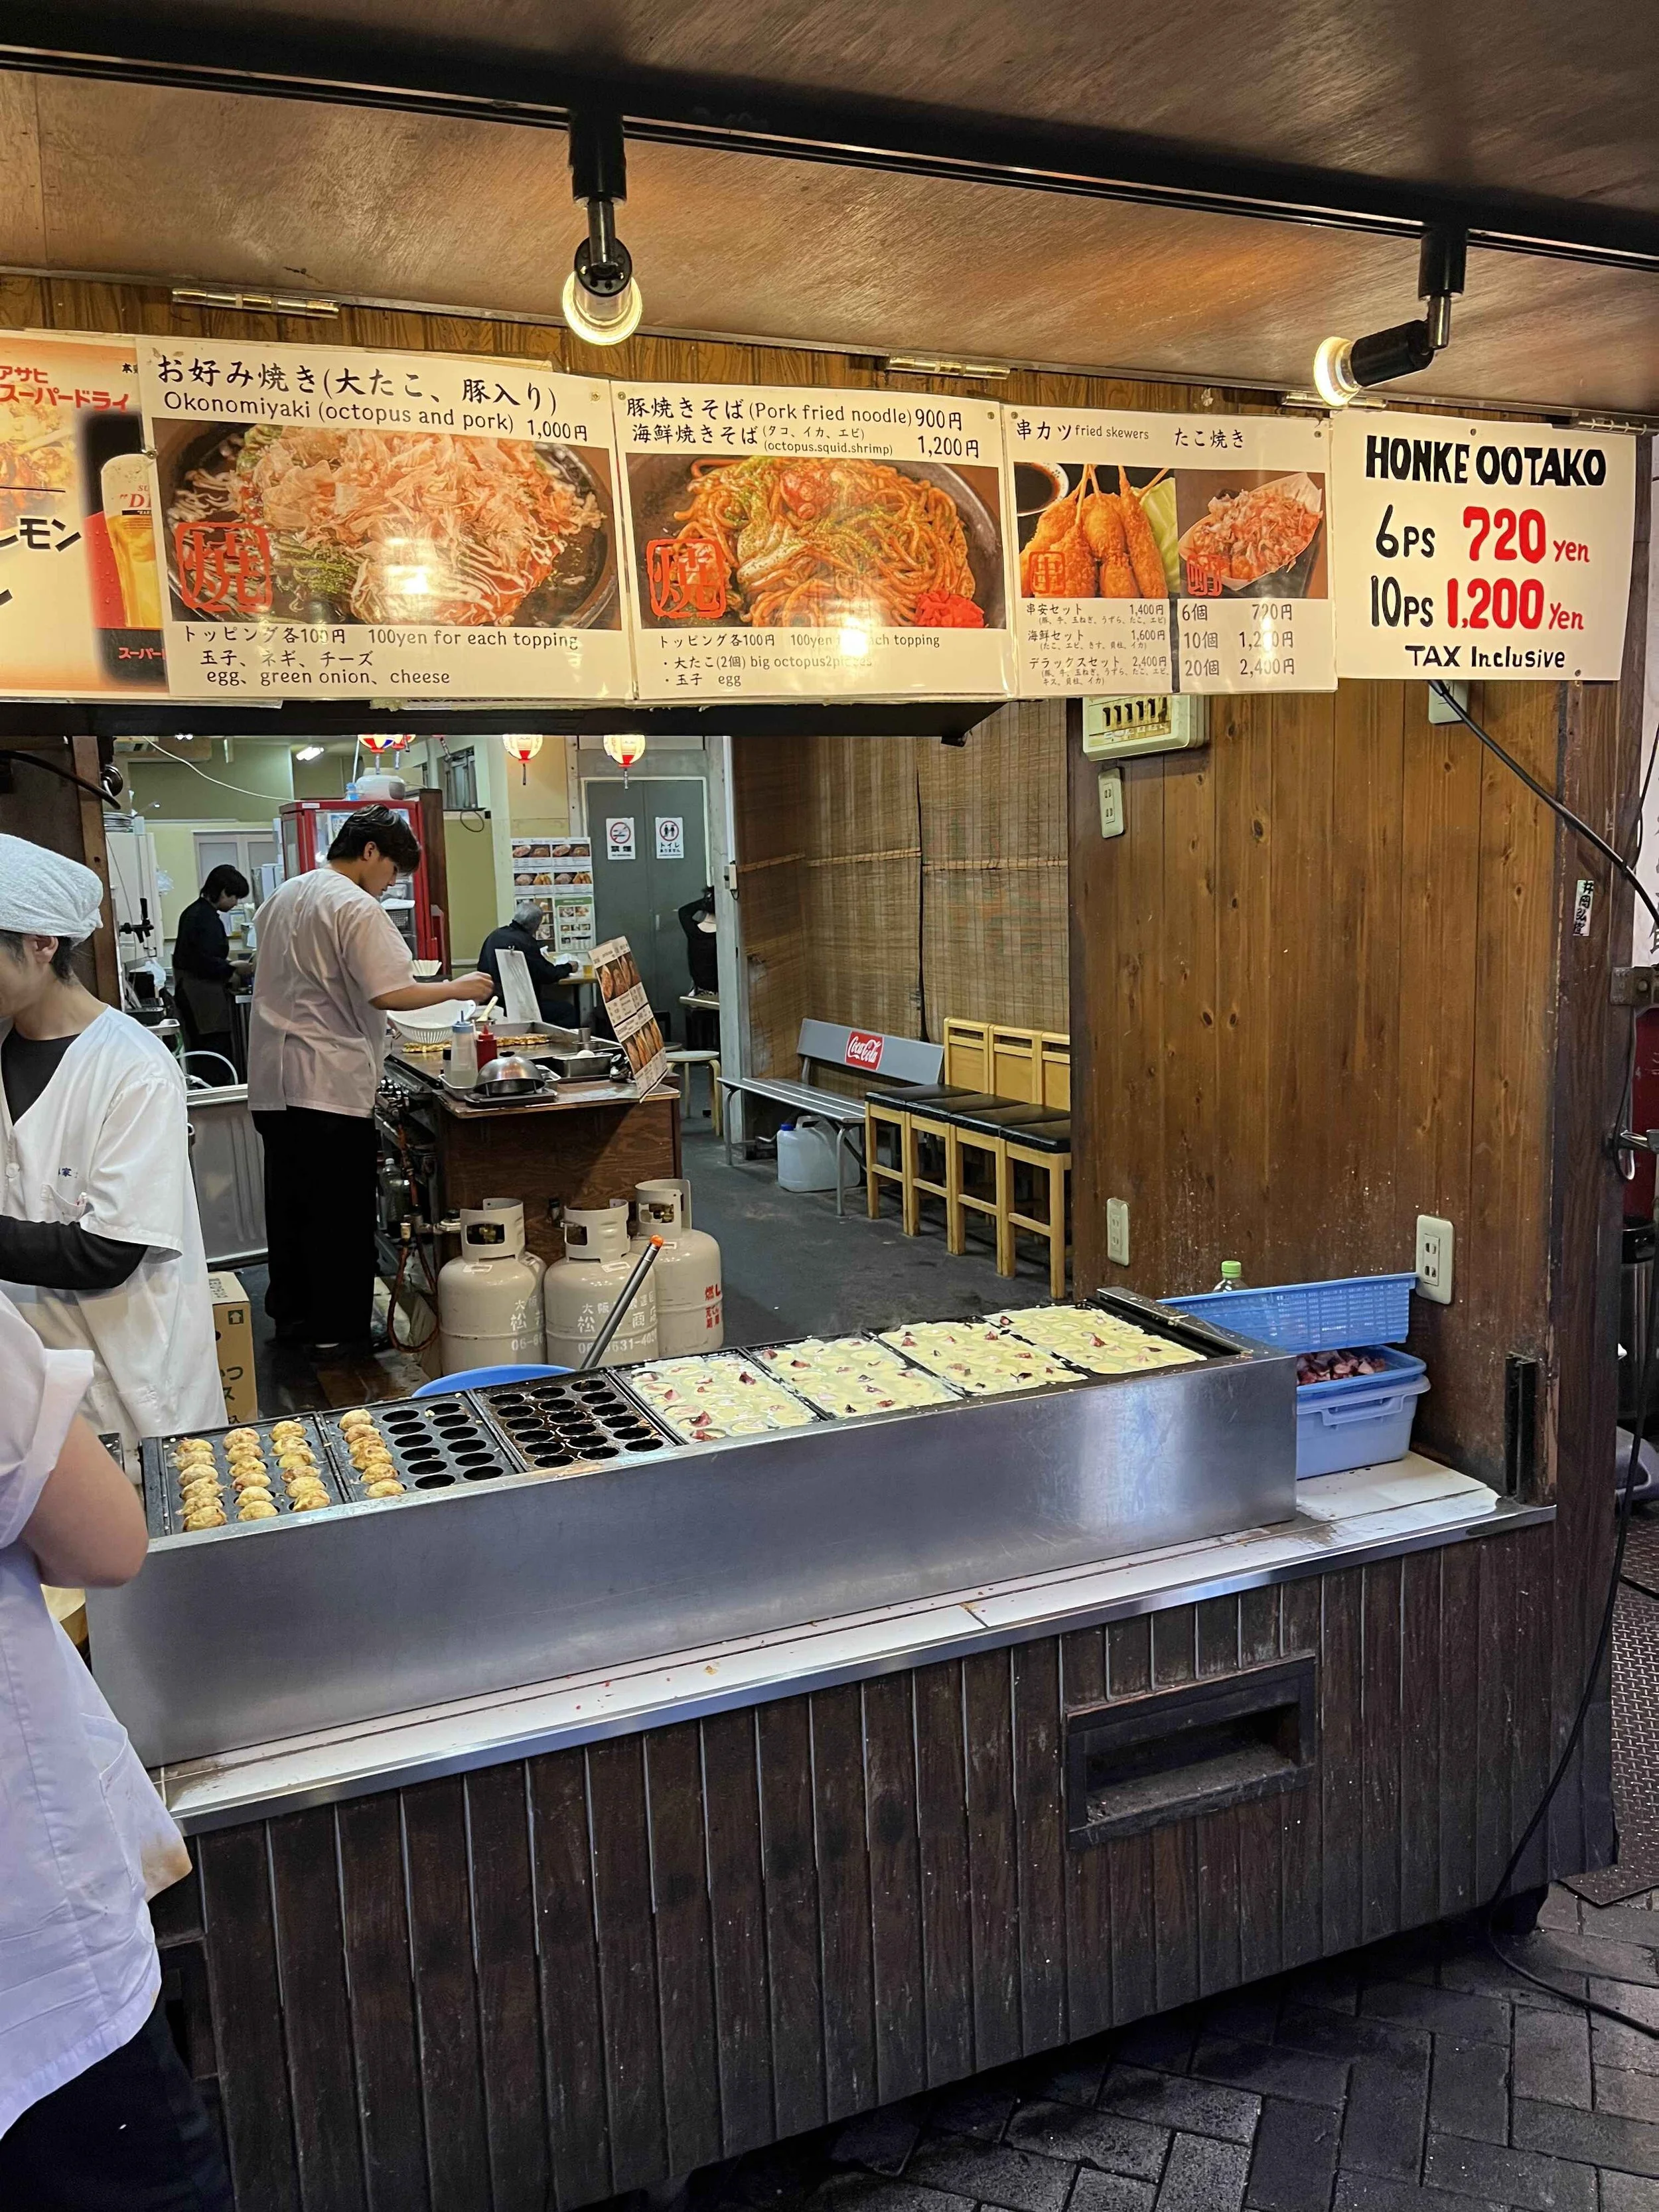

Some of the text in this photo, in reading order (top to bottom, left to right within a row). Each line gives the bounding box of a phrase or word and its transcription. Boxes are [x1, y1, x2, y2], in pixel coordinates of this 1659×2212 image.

[0, 366, 48, 384] アサヒ
[158, 354, 556, 417] お好み焼き(大たこ、豚入り)
[0, 384, 129, 412] スーパードライ
[164, 392, 588, 442] Okonomiyaki (octopus and pork) 1,000円
[626, 396, 962, 431] 豚焼きそば (Pork fried noodle) 900円
[632, 423, 758, 445] 海鮮焼きそば
[918, 435, 979, 459] 1,200円
[1017, 419, 1244, 449] 串カツ fried skewers たこ焼き
[764, 441, 893, 456] (octopus.squid.shrimp)
[1366, 435, 1607, 486] HONKE OOTAKO
[0, 518, 82, 552] モン
[1463, 506, 1546, 564] 720
[1553, 540, 1590, 563] yen
[1129, 604, 1164, 616] 1,400円
[1183, 604, 1208, 621] 6個
[1447, 577, 1544, 630] 1,200
[368, 628, 427, 646] 100yen
[434, 630, 461, 644] for
[467, 631, 507, 645] each
[514, 632, 579, 650] topping
[661, 633, 774, 648] トッピング各100円
[790, 634, 832, 648] 100yen
[895, 634, 940, 648] topping
[1028, 630, 1165, 642] 海鮮セット 1,600円
[1184, 631, 1293, 651] 10個 1,20円
[200, 650, 373, 668] 玉子、ネギ、チーズ
[751, 656, 770, 670] big
[1029, 656, 1167, 669] デラックスセット 2,400円
[1405, 645, 1565, 668] TAX Inclusive
[1185, 658, 1220, 676] 20個
[260, 670, 312, 686] green
[390, 670, 450, 684] cheese
[676, 673, 741, 687] 玉子 egg
